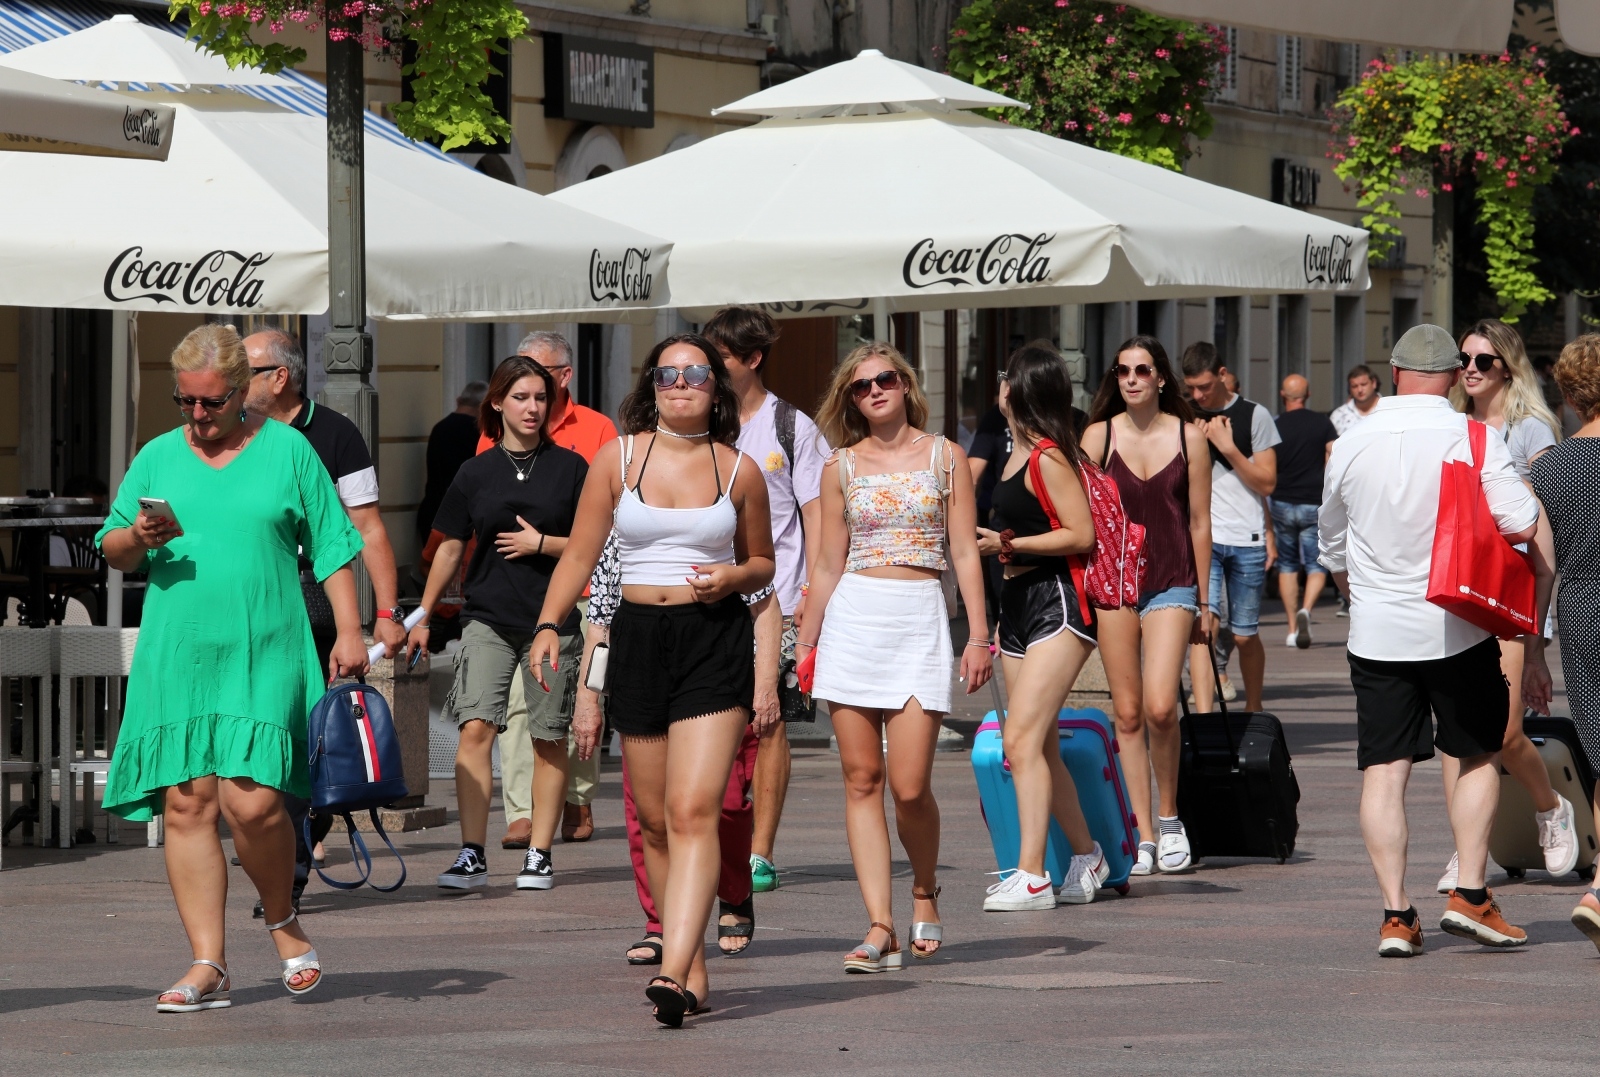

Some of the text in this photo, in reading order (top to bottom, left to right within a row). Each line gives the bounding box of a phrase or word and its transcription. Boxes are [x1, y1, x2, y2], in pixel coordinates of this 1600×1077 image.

[569, 50, 648, 112] NARACAMICIE
[123, 105, 160, 147] Coca-Cola
[103, 246, 275, 308] Coca-Cola
[589, 247, 652, 302] Coca-Cola
[902, 232, 1057, 289] Coca-Cola
[1304, 234, 1353, 284] Coca-Cola
